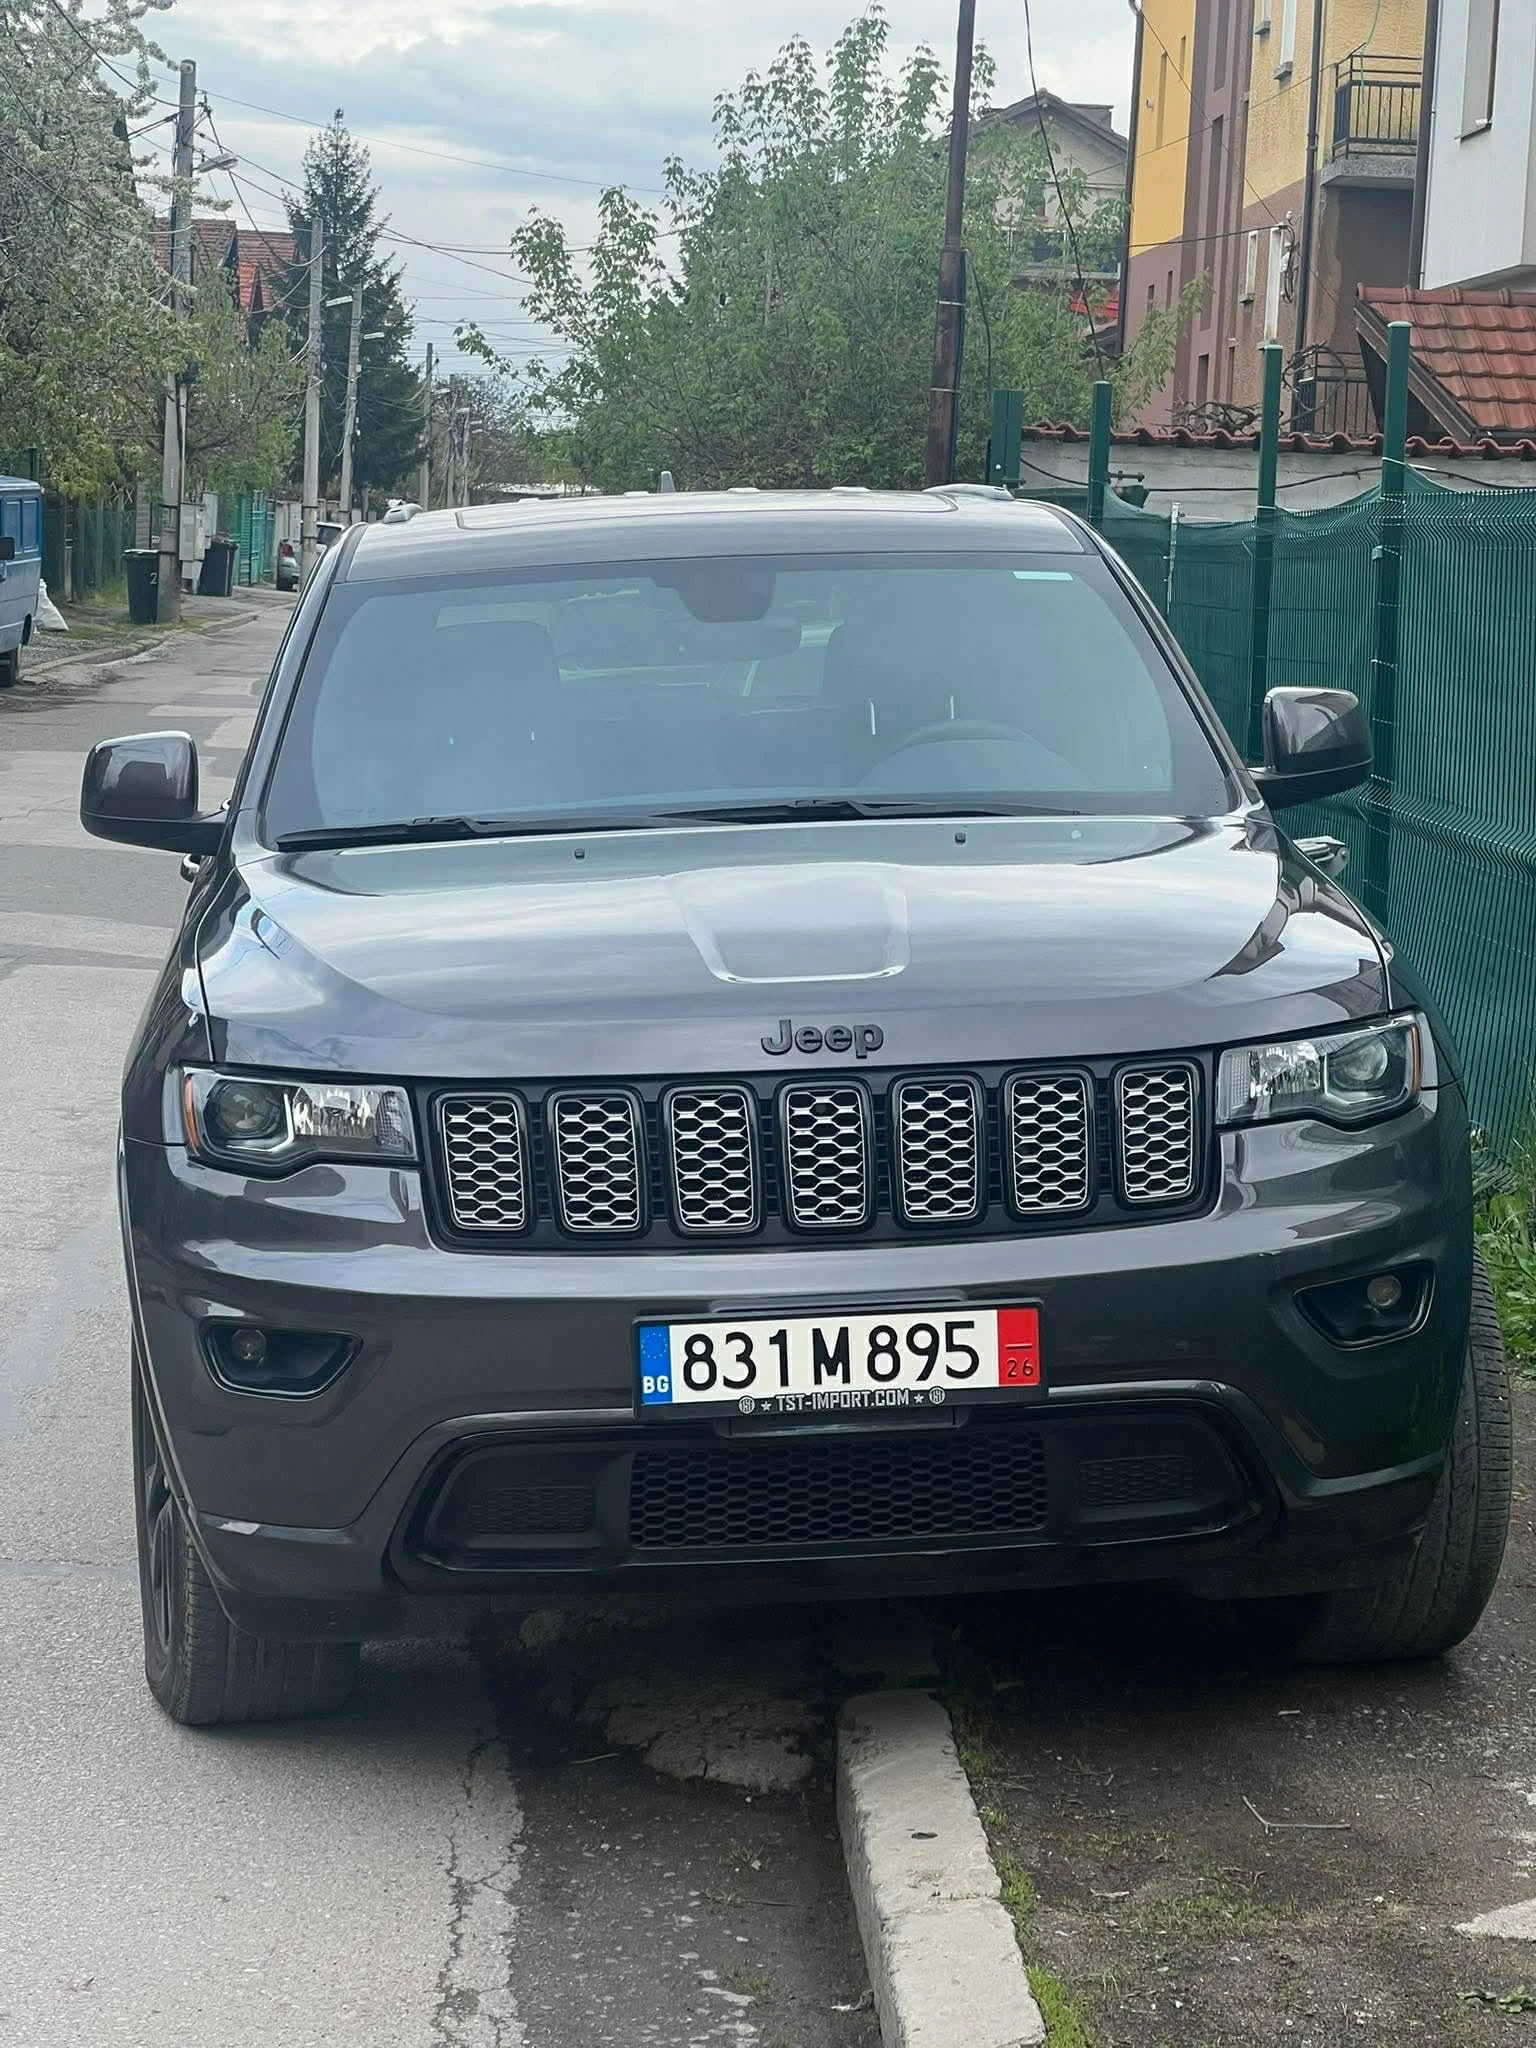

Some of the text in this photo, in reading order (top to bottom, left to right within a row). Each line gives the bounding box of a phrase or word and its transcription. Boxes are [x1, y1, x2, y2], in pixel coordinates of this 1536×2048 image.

[760, 1019, 884, 1059] Jeep
[1007, 1358, 1033, 1378] 26
[643, 1375, 669, 1394] BG
[776, 1389, 909, 1411] TST-IMPORT.COM
